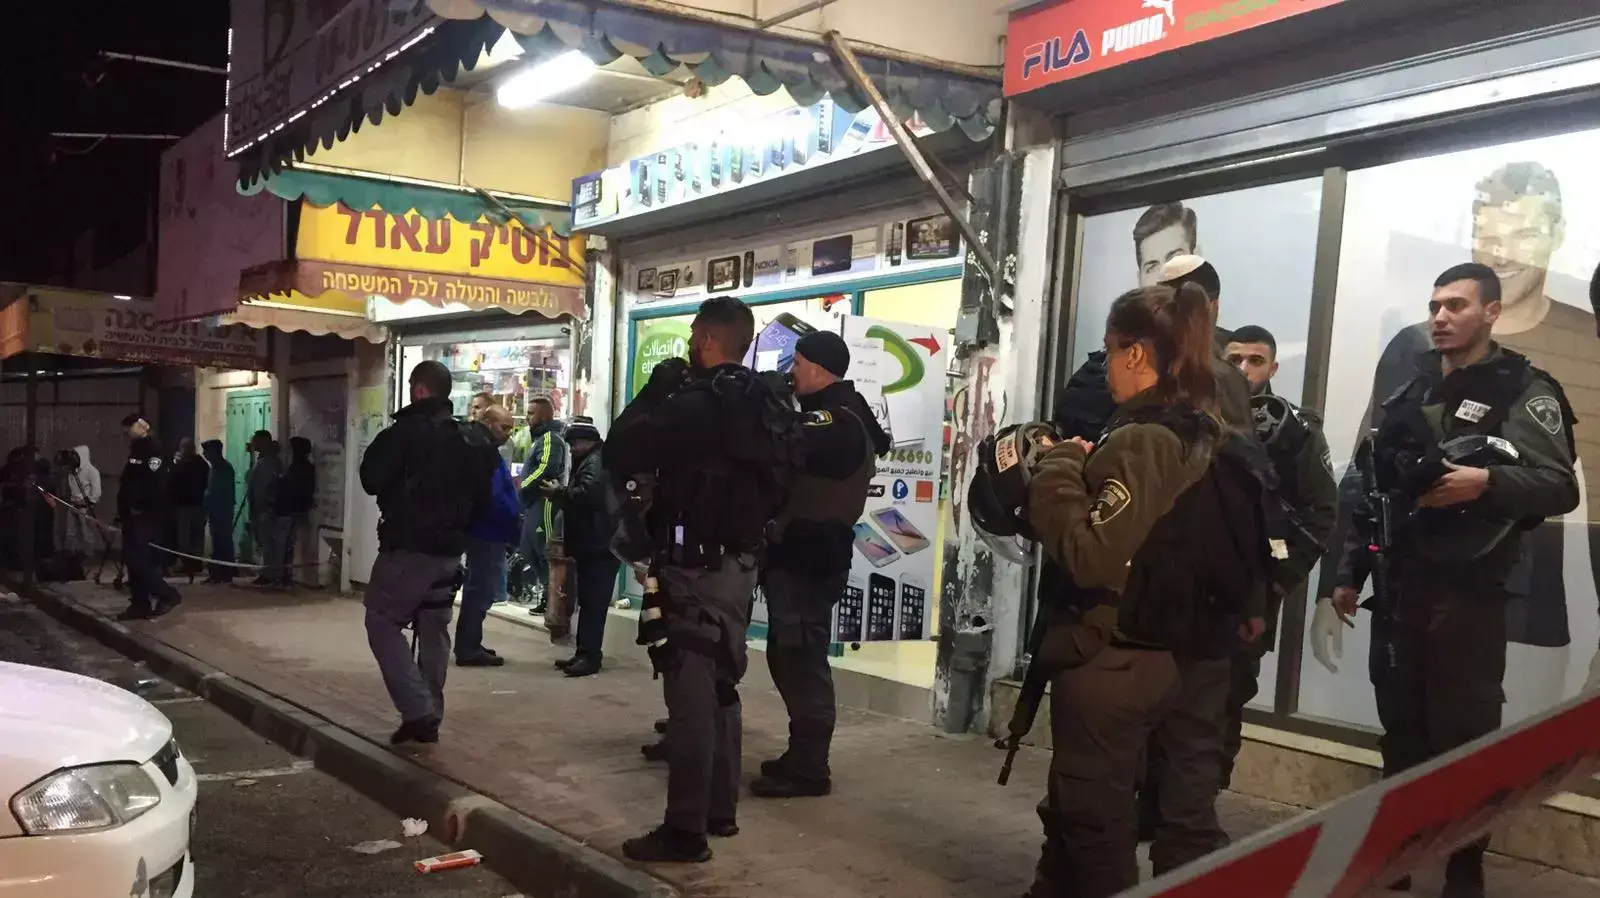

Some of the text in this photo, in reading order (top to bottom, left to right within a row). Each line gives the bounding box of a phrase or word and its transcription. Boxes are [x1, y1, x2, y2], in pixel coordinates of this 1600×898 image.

[1022, 28, 1091, 80] FILA
[1101, 14, 1164, 56] PUMA
[469, 213, 571, 269] בוטיק
[755, 259, 780, 270] NOKIA
[321, 270, 558, 309] הלבשה והנעלה לכל המשפחה
